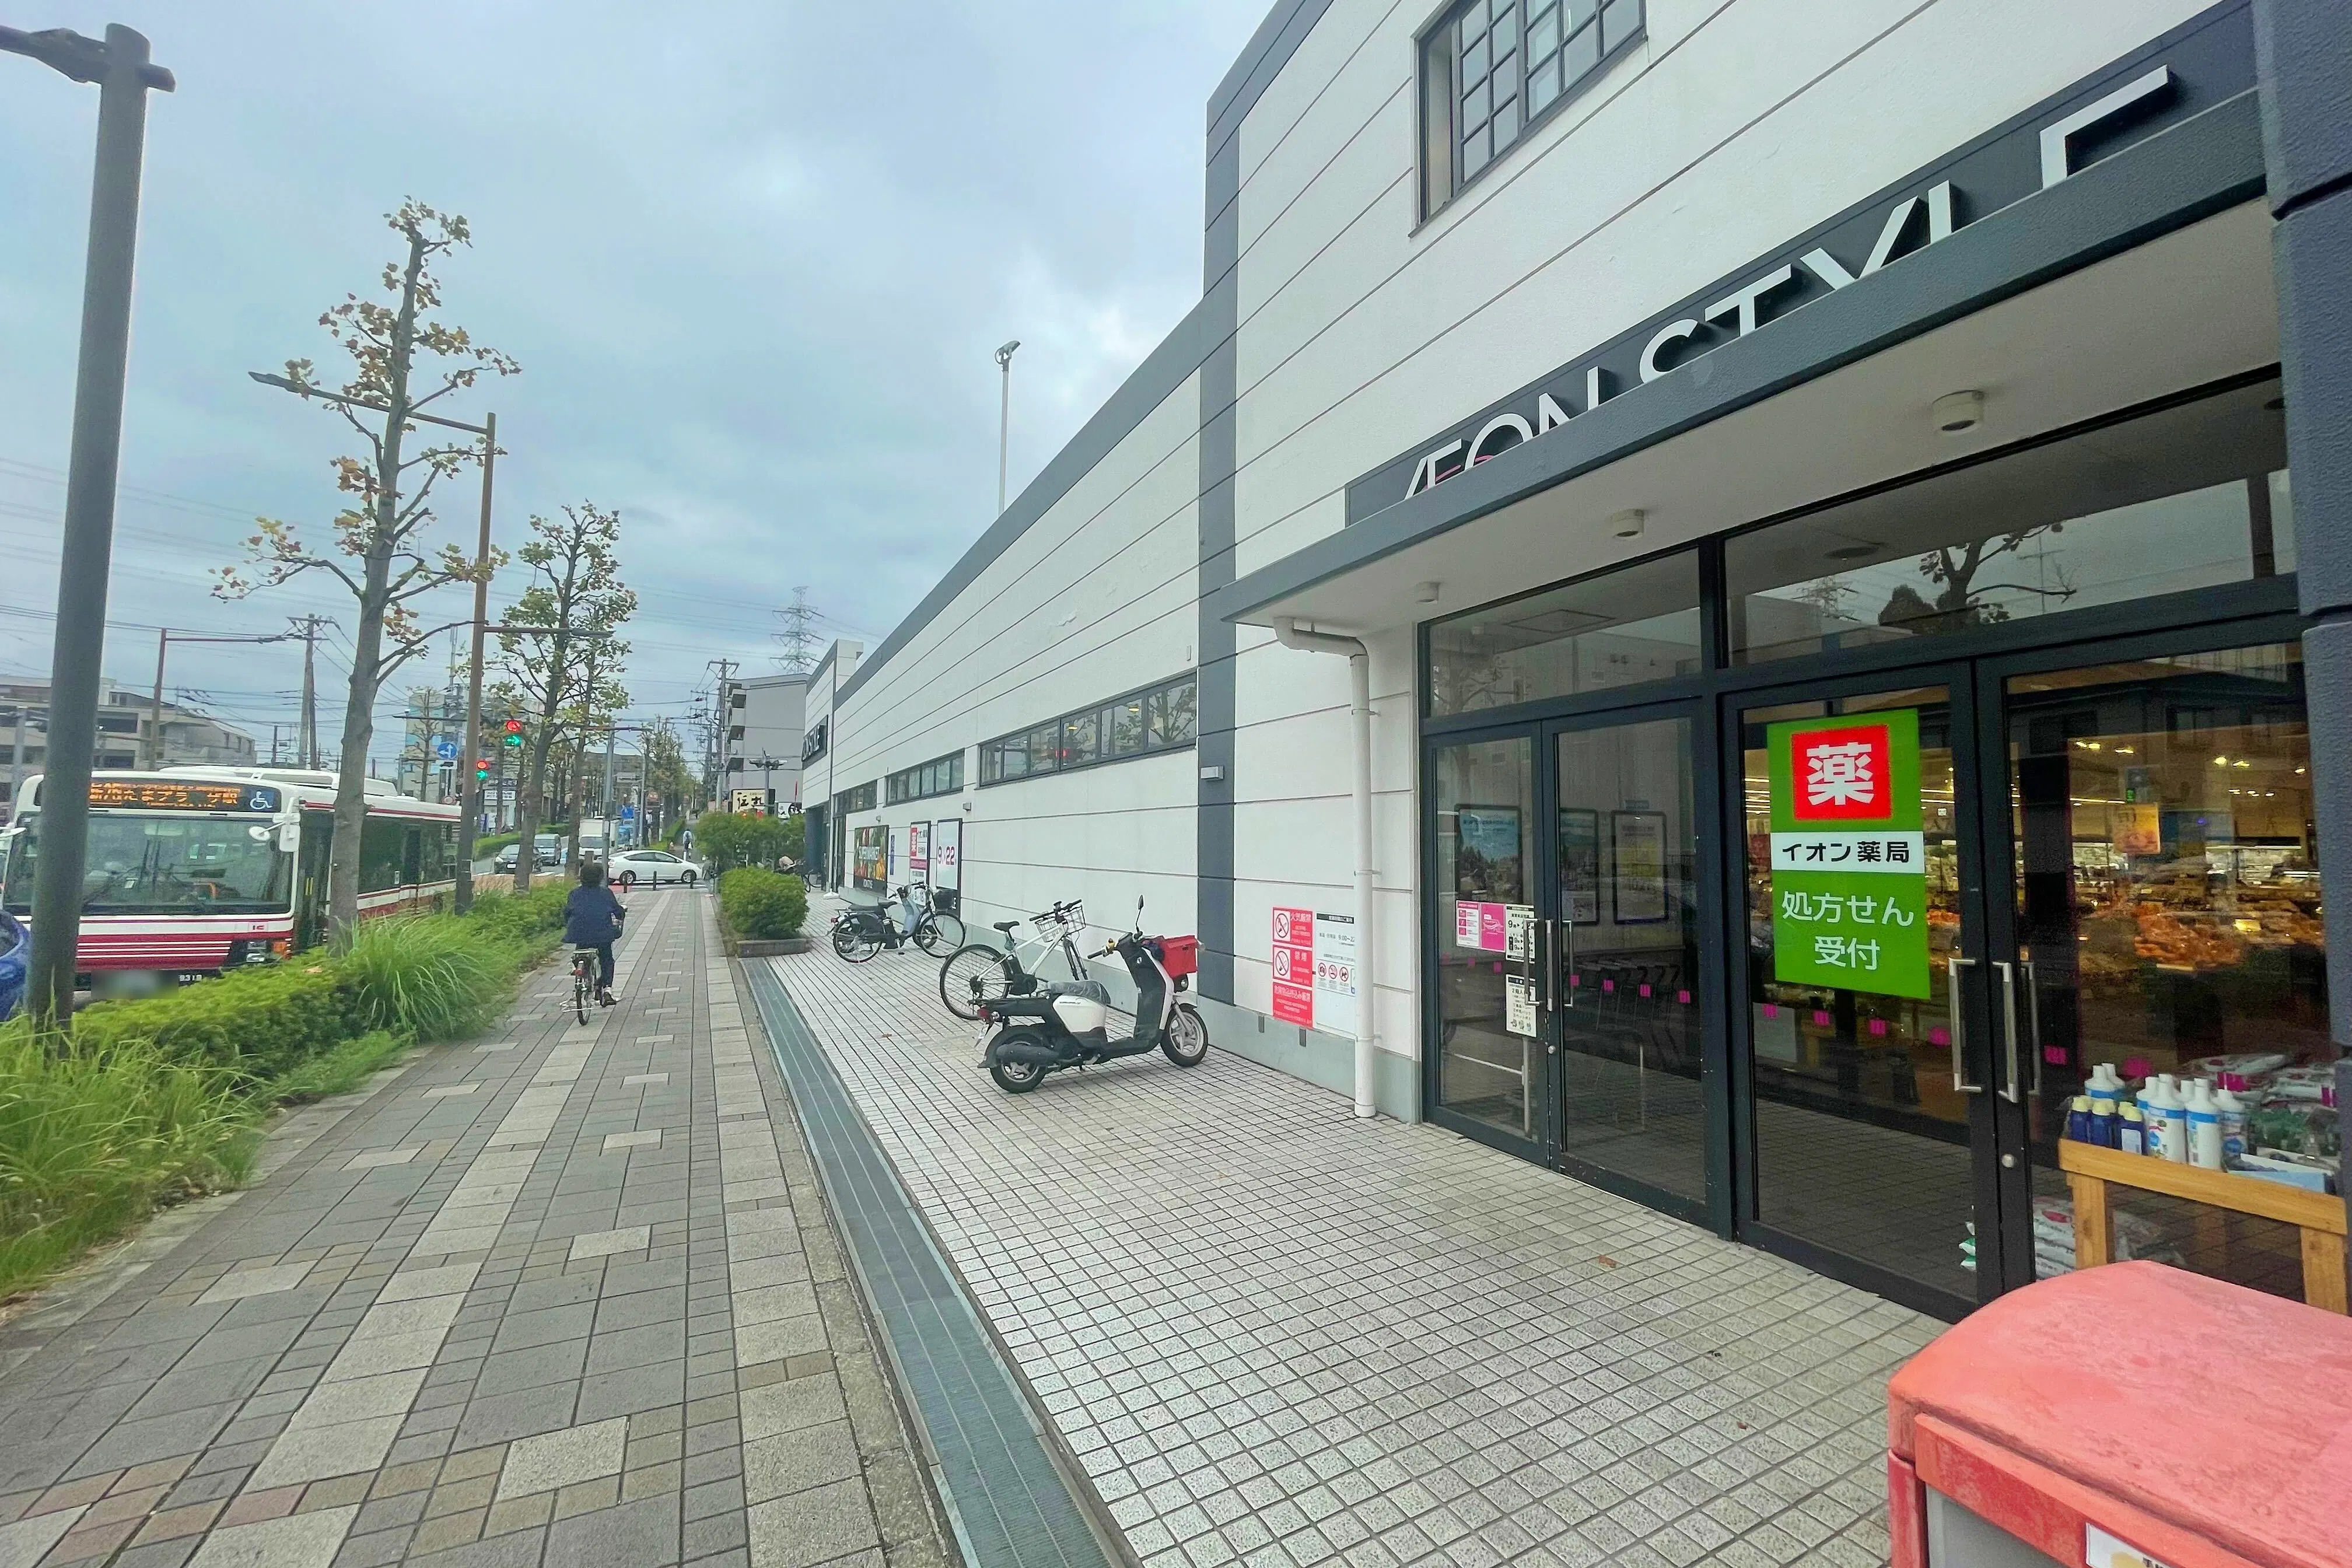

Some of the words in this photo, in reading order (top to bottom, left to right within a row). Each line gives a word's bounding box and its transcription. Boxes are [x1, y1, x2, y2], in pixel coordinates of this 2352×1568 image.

[1806, 742, 1874, 806] 薬
[1782, 841, 1910, 863] イオン薬局
[1782, 891, 1913, 927] 処方せん
[1814, 936, 1880, 971] 受付
